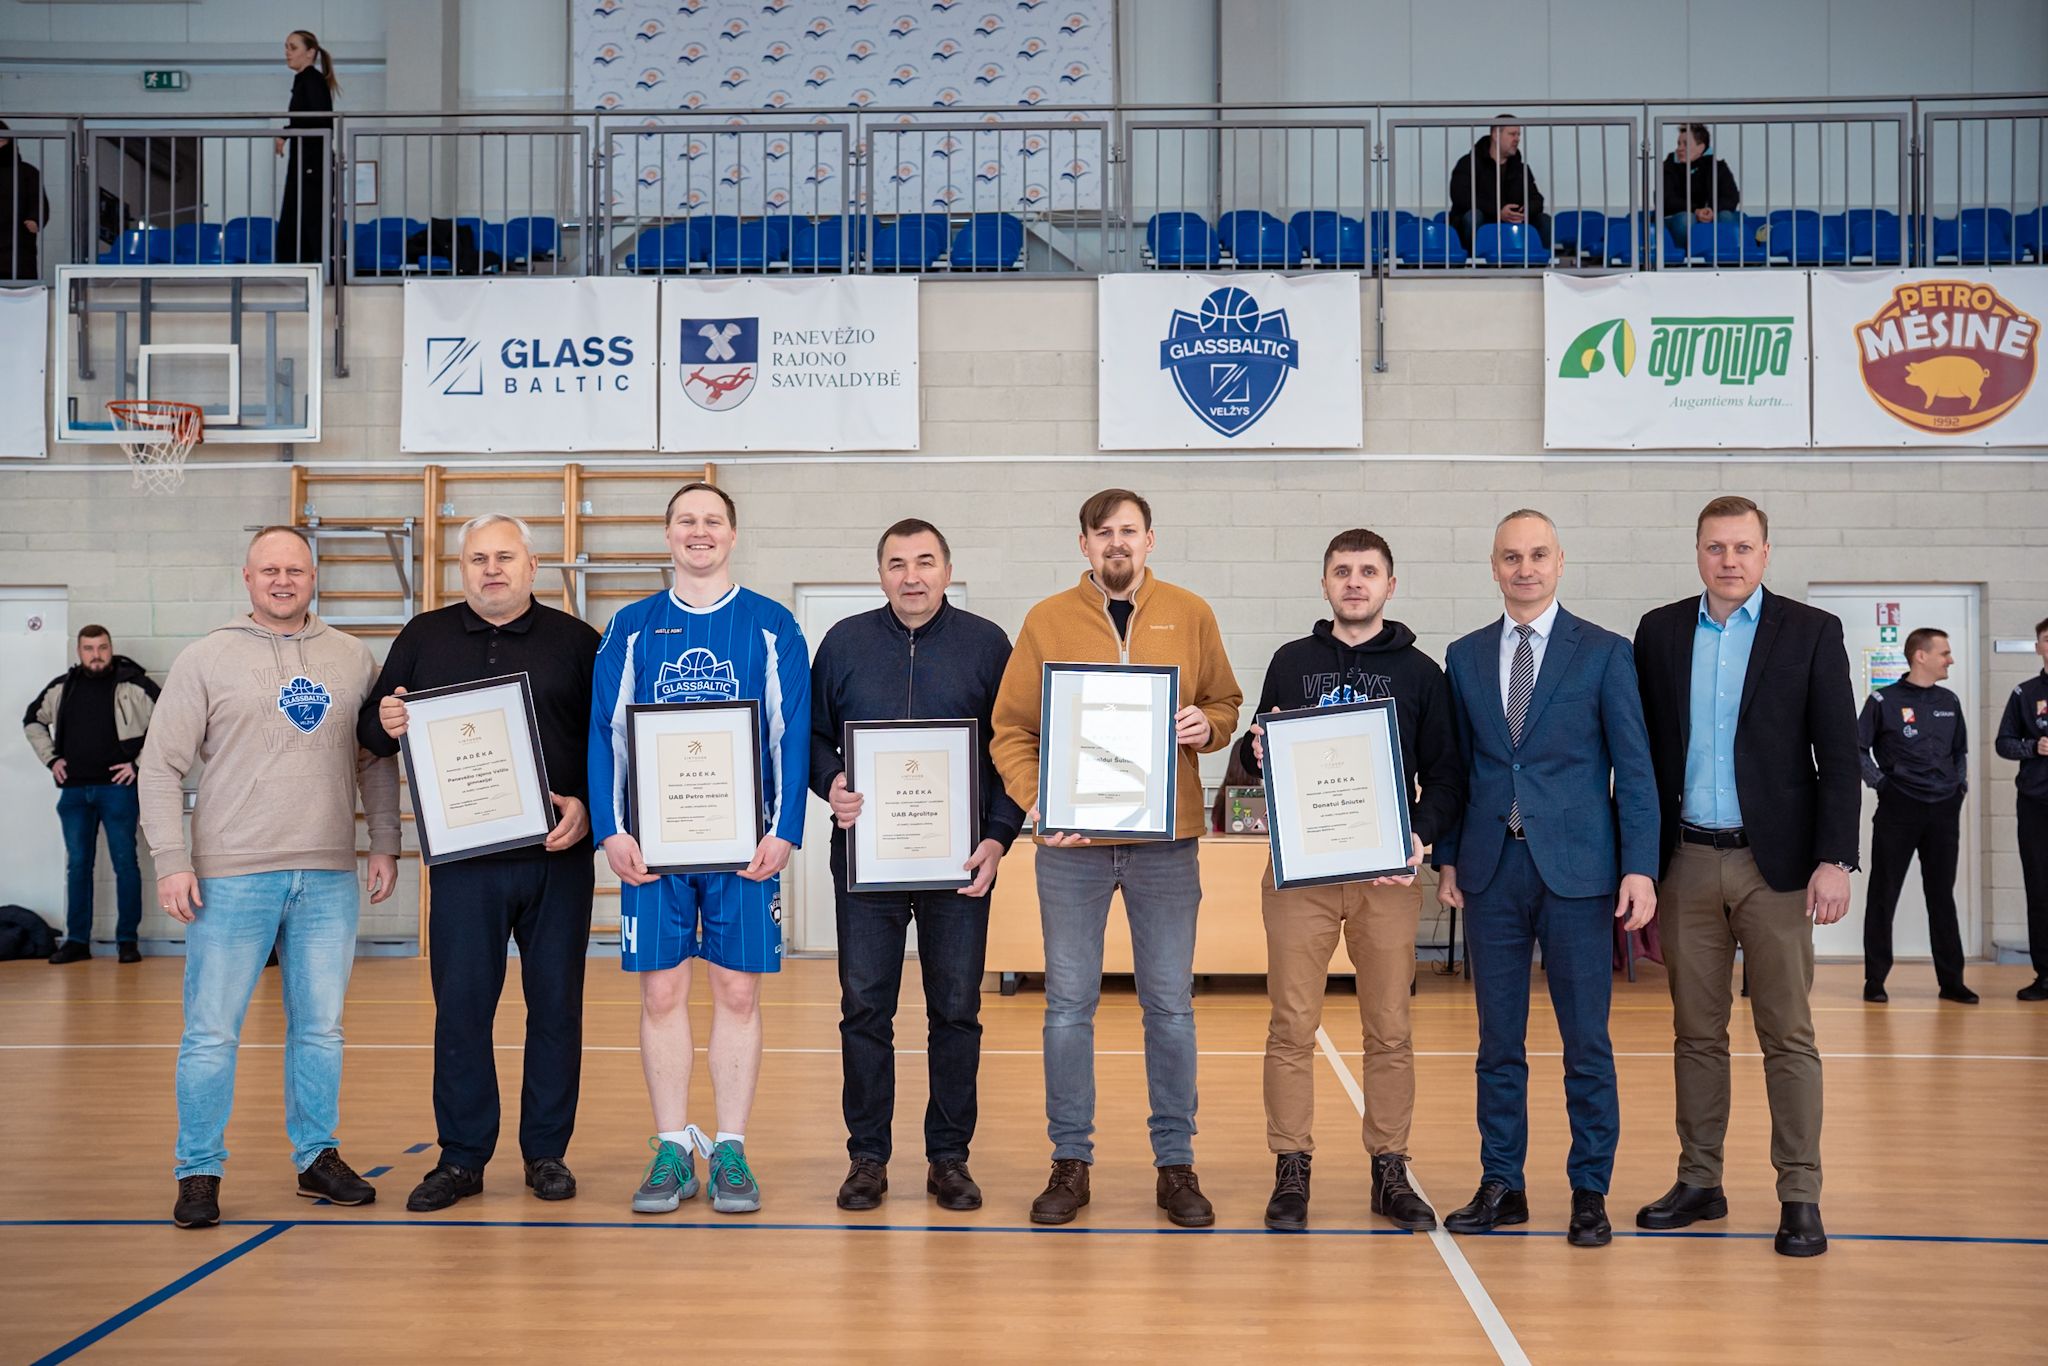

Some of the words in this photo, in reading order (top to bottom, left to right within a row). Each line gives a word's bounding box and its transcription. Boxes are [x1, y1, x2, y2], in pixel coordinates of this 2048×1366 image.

[1900, 285, 1992, 311] PETRO
[772, 326, 875, 345] PANEVĖŽIO
[1861, 310, 2033, 363] MĖSINĖ
[501, 335, 634, 369] GLASS
[1169, 338, 1290, 360] GLASSBALTIC
[772, 351, 846, 366] RAJONO
[504, 374, 629, 394] BALTIC
[772, 369, 901, 388] SAVIVALDYBĖ
[1209, 405, 1250, 416] VELŽYS
[1669, 395, 1744, 410] Augantiems
[1933, 417, 1960, 428] 1992
[662, 680, 732, 695] GLASSBALTIC
[282, 694, 327, 705] GLASSBALTIC
[456, 750, 493, 762] PADĖKA
